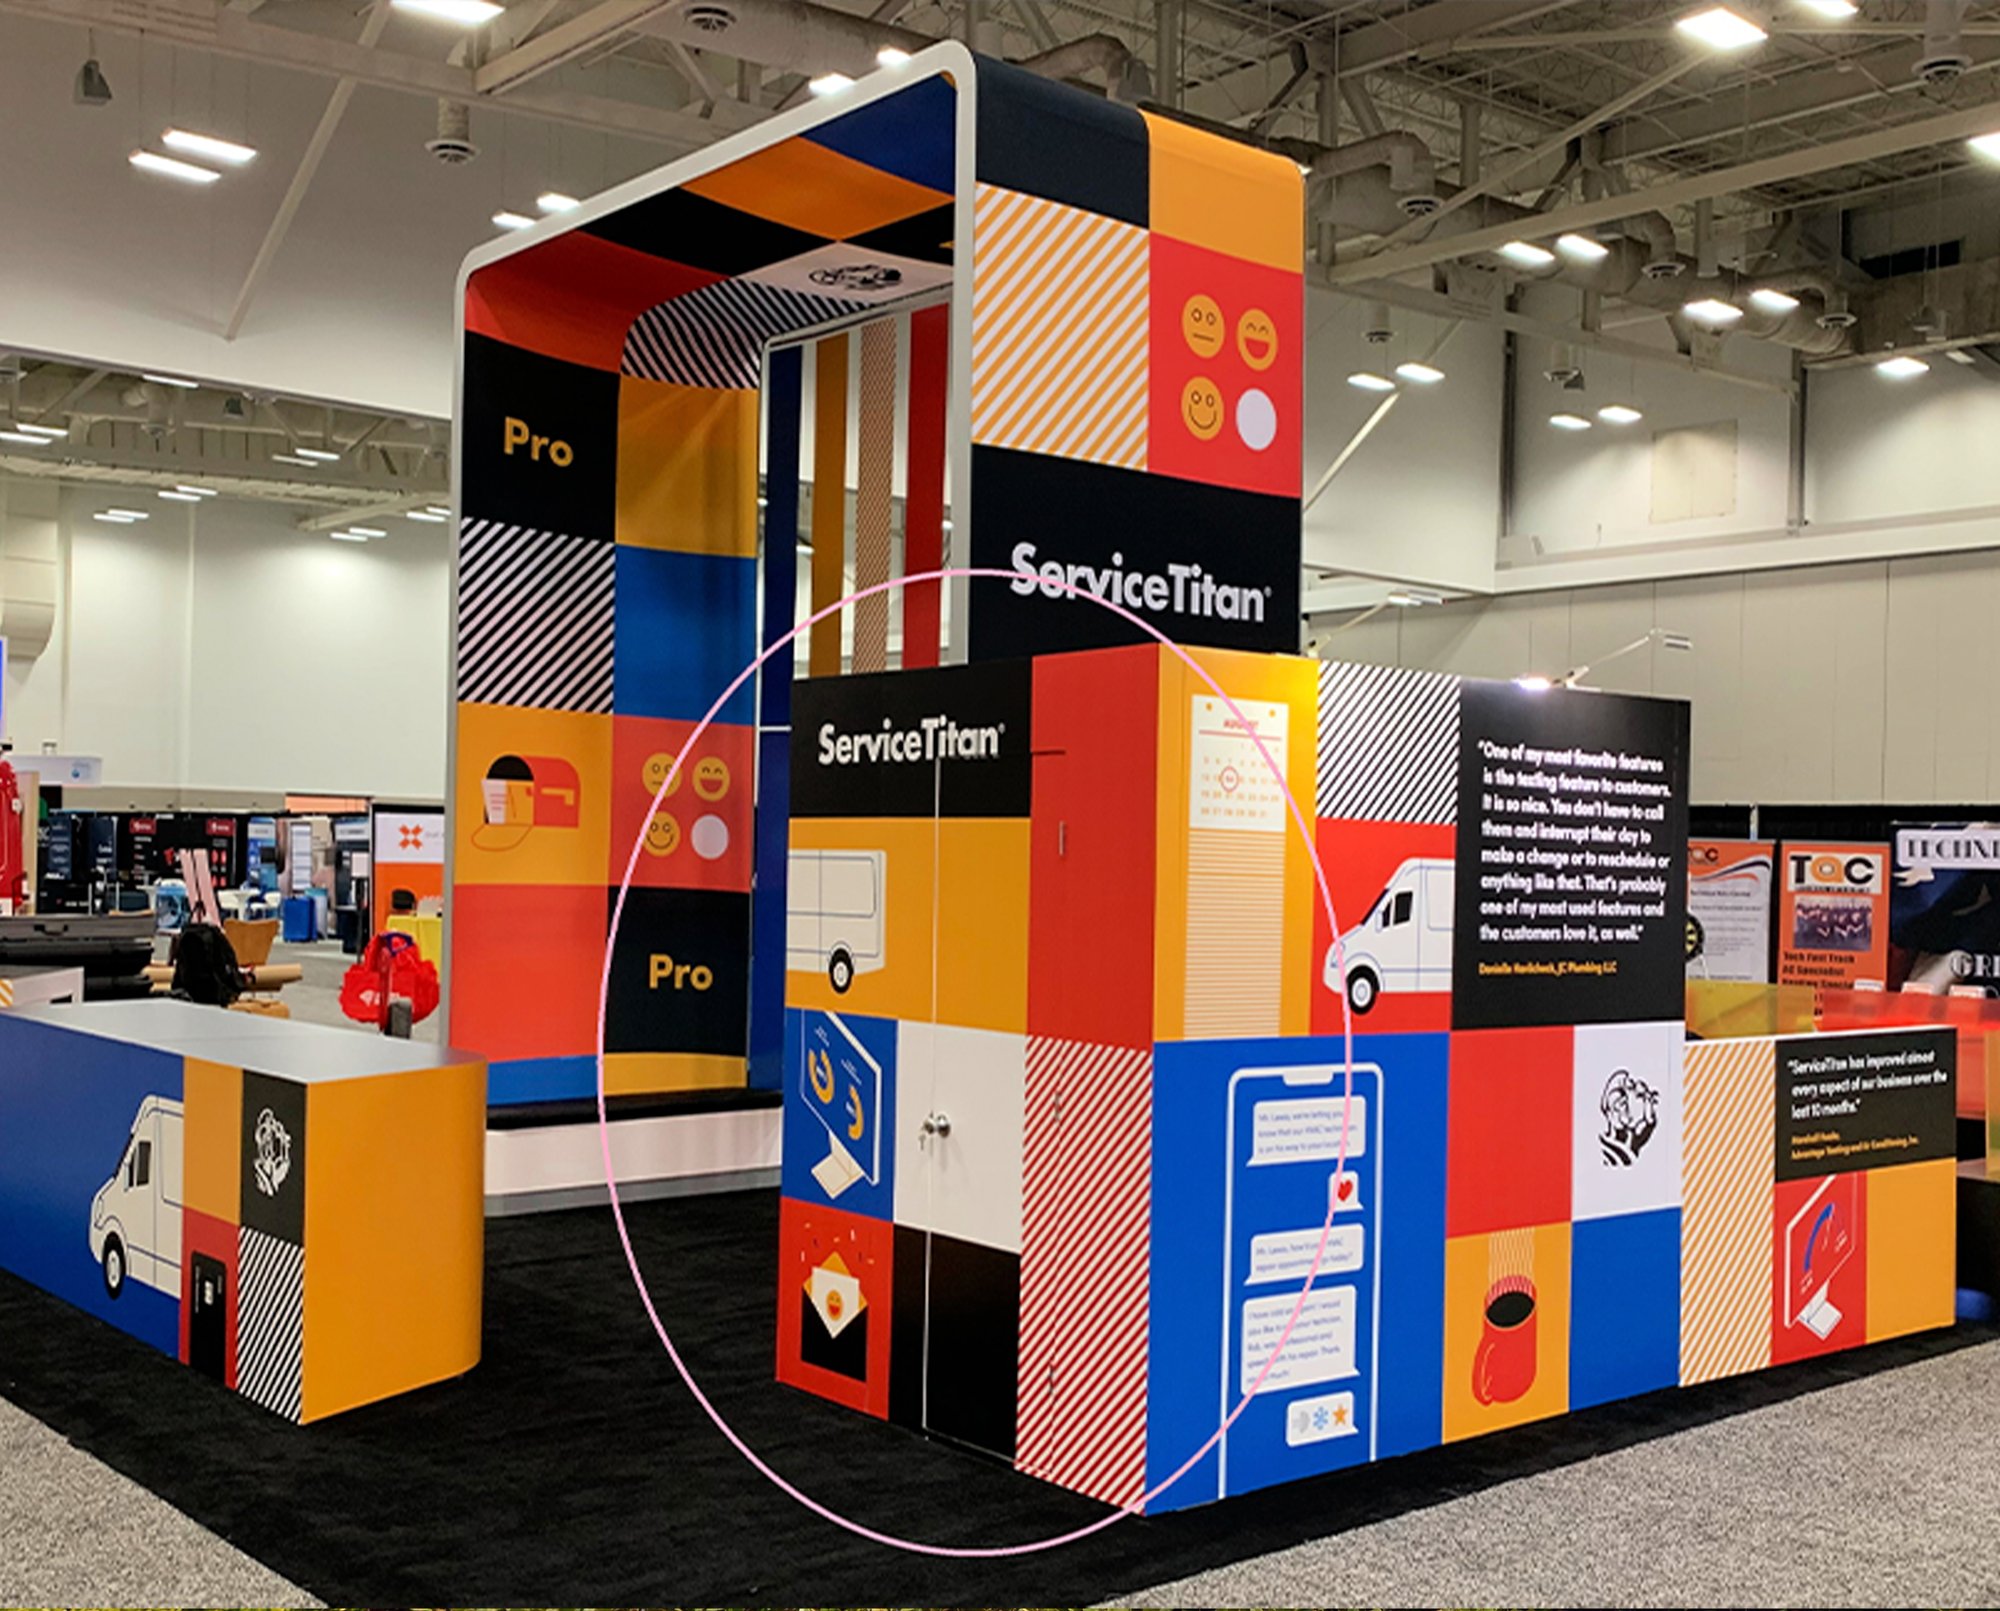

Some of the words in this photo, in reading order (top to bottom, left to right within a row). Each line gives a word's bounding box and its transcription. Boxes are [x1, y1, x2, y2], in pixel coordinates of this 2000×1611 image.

[504, 416, 574, 467] Pro
[1010, 541, 1265, 622] ServiceTitan
[818, 714, 999, 765] ServiceTitan
[1516, 851, 1524, 864] a
[649, 953, 713, 991] Pro
